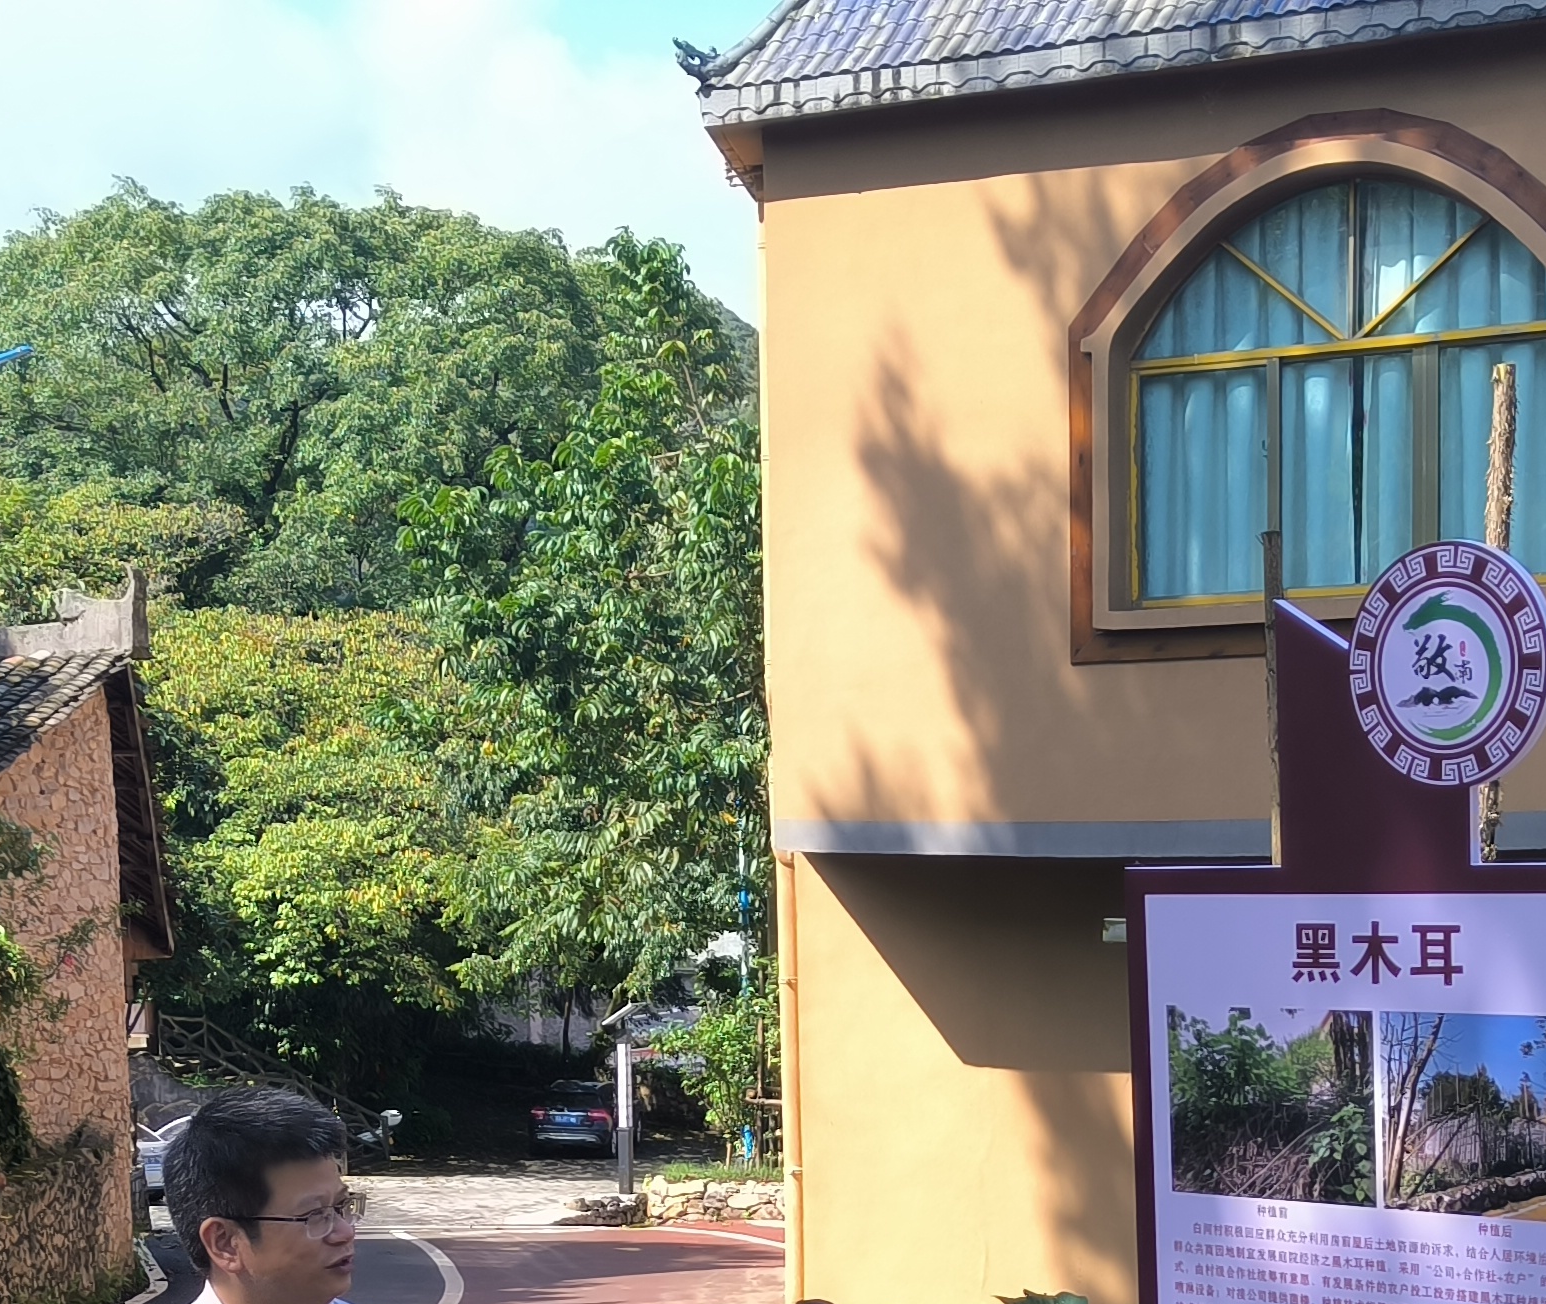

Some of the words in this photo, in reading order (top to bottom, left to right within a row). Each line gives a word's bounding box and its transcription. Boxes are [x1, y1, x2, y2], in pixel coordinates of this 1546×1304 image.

[1291, 920, 1464, 986] 黑木耳
[1256, 1204, 1288, 1220] 种植前
[1478, 1222, 1513, 1239] 种植后
